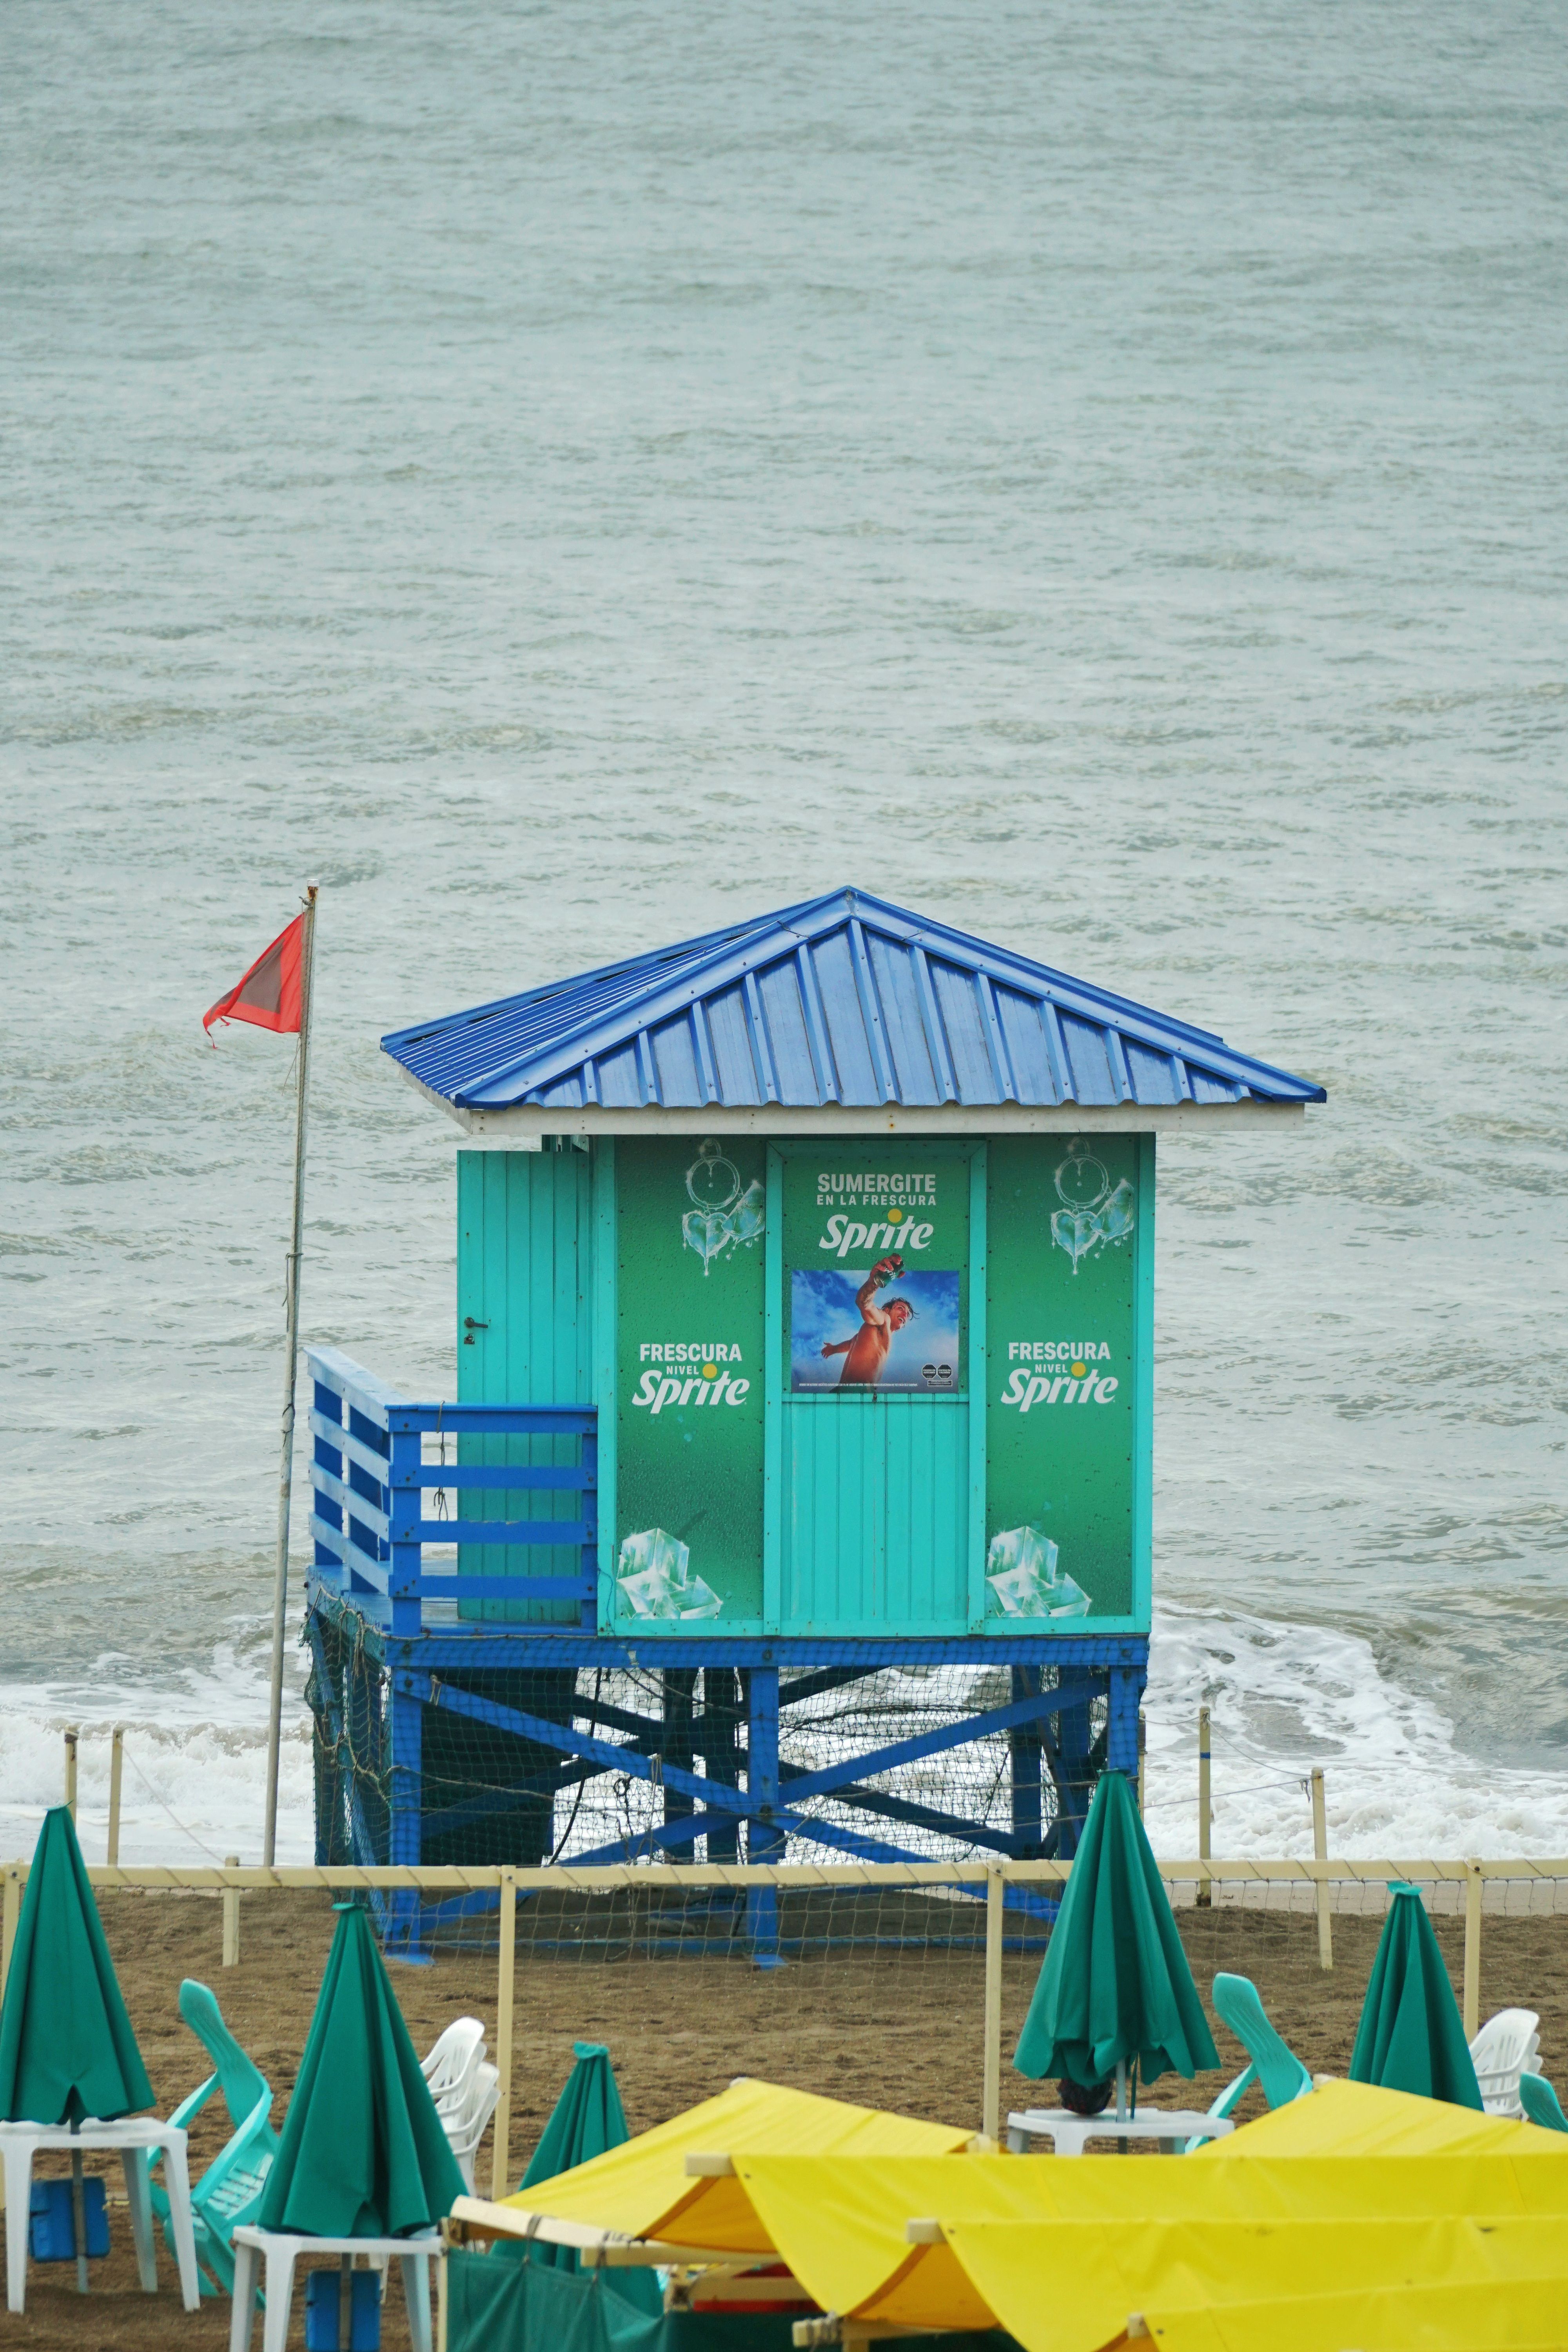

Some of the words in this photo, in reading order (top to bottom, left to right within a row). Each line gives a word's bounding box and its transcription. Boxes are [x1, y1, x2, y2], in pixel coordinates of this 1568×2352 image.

[817, 1174, 936, 1193] SUMERGITE
[817, 1194, 834, 1205] EN
[840, 1194, 857, 1205] LA
[862, 1194, 936, 1206] FRESCURA
[818, 1209, 934, 1257] Sprite
[640, 1343, 742, 1362] FRESCURA
[1008, 1342, 1111, 1360] FRESCURA
[666, 1365, 699, 1375] NIVEL
[1034, 1364, 1068, 1374] NIVEL
[632, 1363, 750, 1414] Sprite
[1001, 1362, 1119, 1412] Sprite
